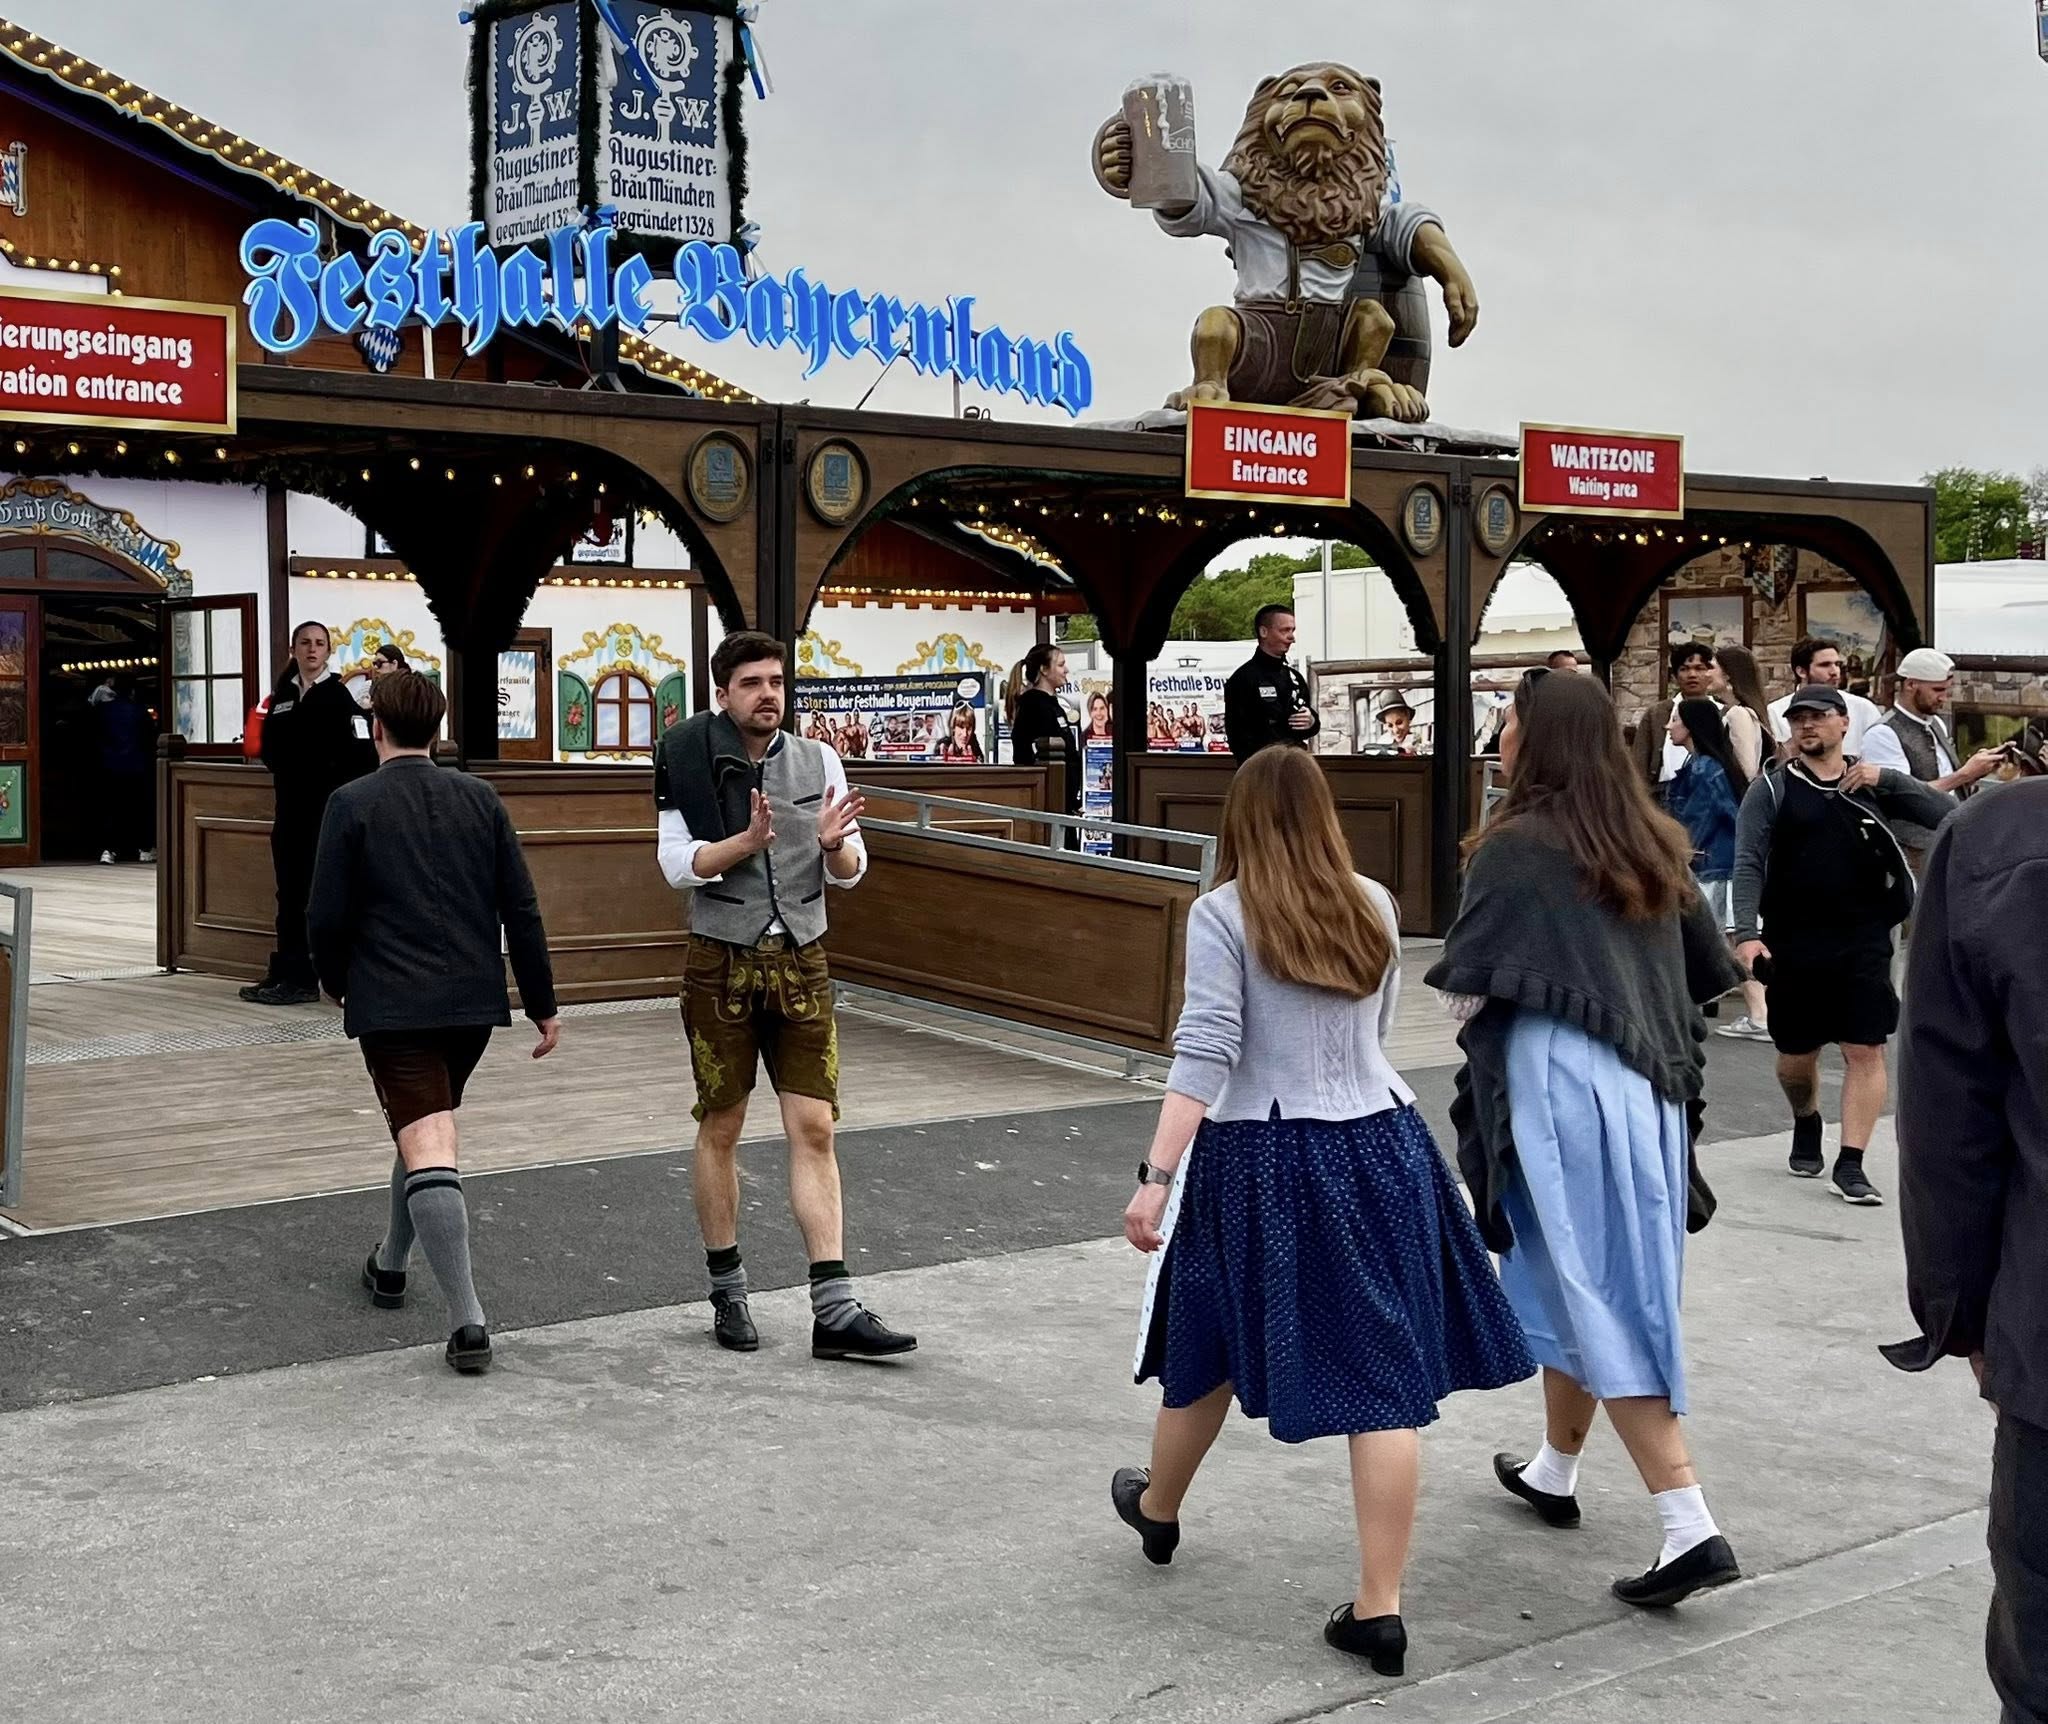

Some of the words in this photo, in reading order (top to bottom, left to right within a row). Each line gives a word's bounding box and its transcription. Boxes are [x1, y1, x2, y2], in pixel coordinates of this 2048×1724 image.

[495, 212, 552, 244] gegründet
[552, 206, 577, 229] 132
[611, 209, 685, 233] gegründet
[685, 214, 714, 238] 1328
[238, 218, 655, 357] Festhalle
[677, 238, 1093, 418] Bayernland
[0, 316, 193, 369] erungseingang
[0, 364, 68, 397] ation
[75, 373, 183, 405] entrance
[1223, 426, 1318, 458] EINGANG
[1232, 459, 1308, 486] Entrance
[1550, 443, 1656, 475] WARTEZONE
[1568, 476, 1611, 500] Waiting
[1612, 480, 1639, 499] area
[51, 500, 92, 528] Gott
[1149, 675, 1202, 692] Festhalle
[803, 696, 828, 710] Stars
[828, 695, 837, 708] in
[838, 695, 854, 708] der
[854, 693, 895, 709] Festhalle
[896, 690, 954, 711] Bayernland
